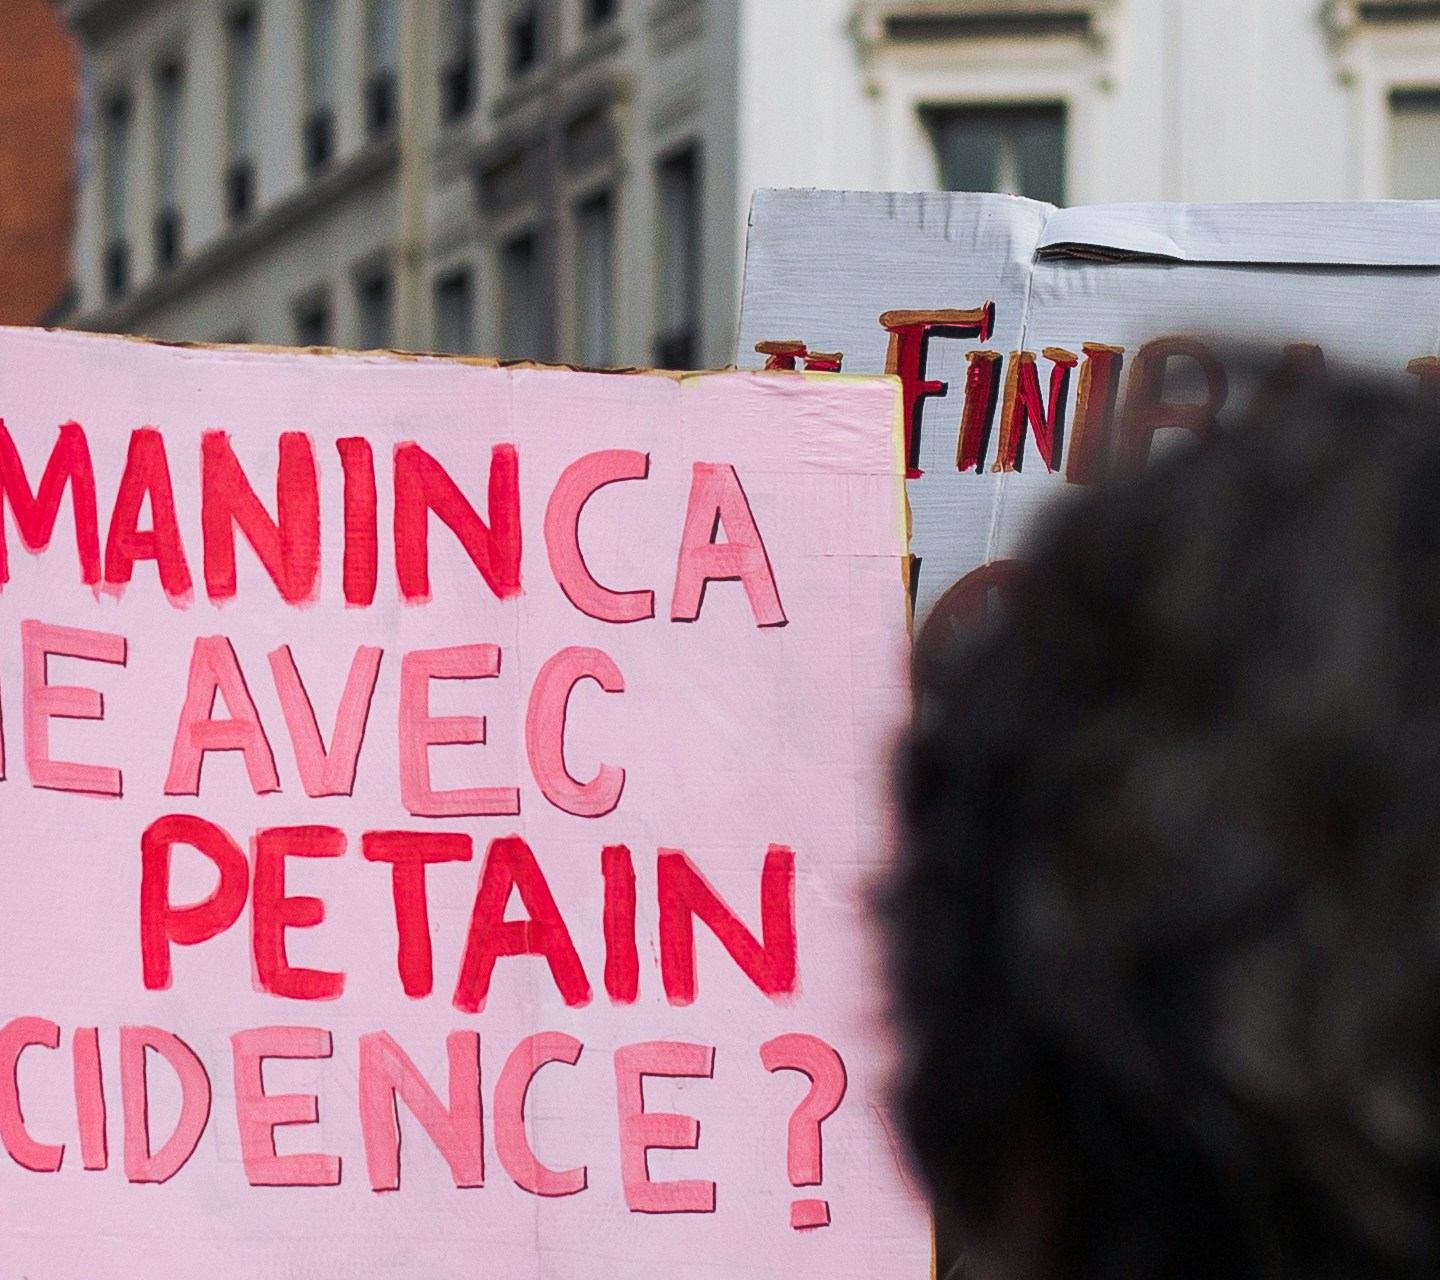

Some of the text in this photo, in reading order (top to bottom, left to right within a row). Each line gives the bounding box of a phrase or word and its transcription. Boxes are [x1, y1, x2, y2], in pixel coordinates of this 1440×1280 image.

[878, 300, 1326, 486] FINIR
[542, 448, 789, 630] CA
[163, 634, 627, 819] AVEC
[138, 812, 802, 1016] PETAIN
